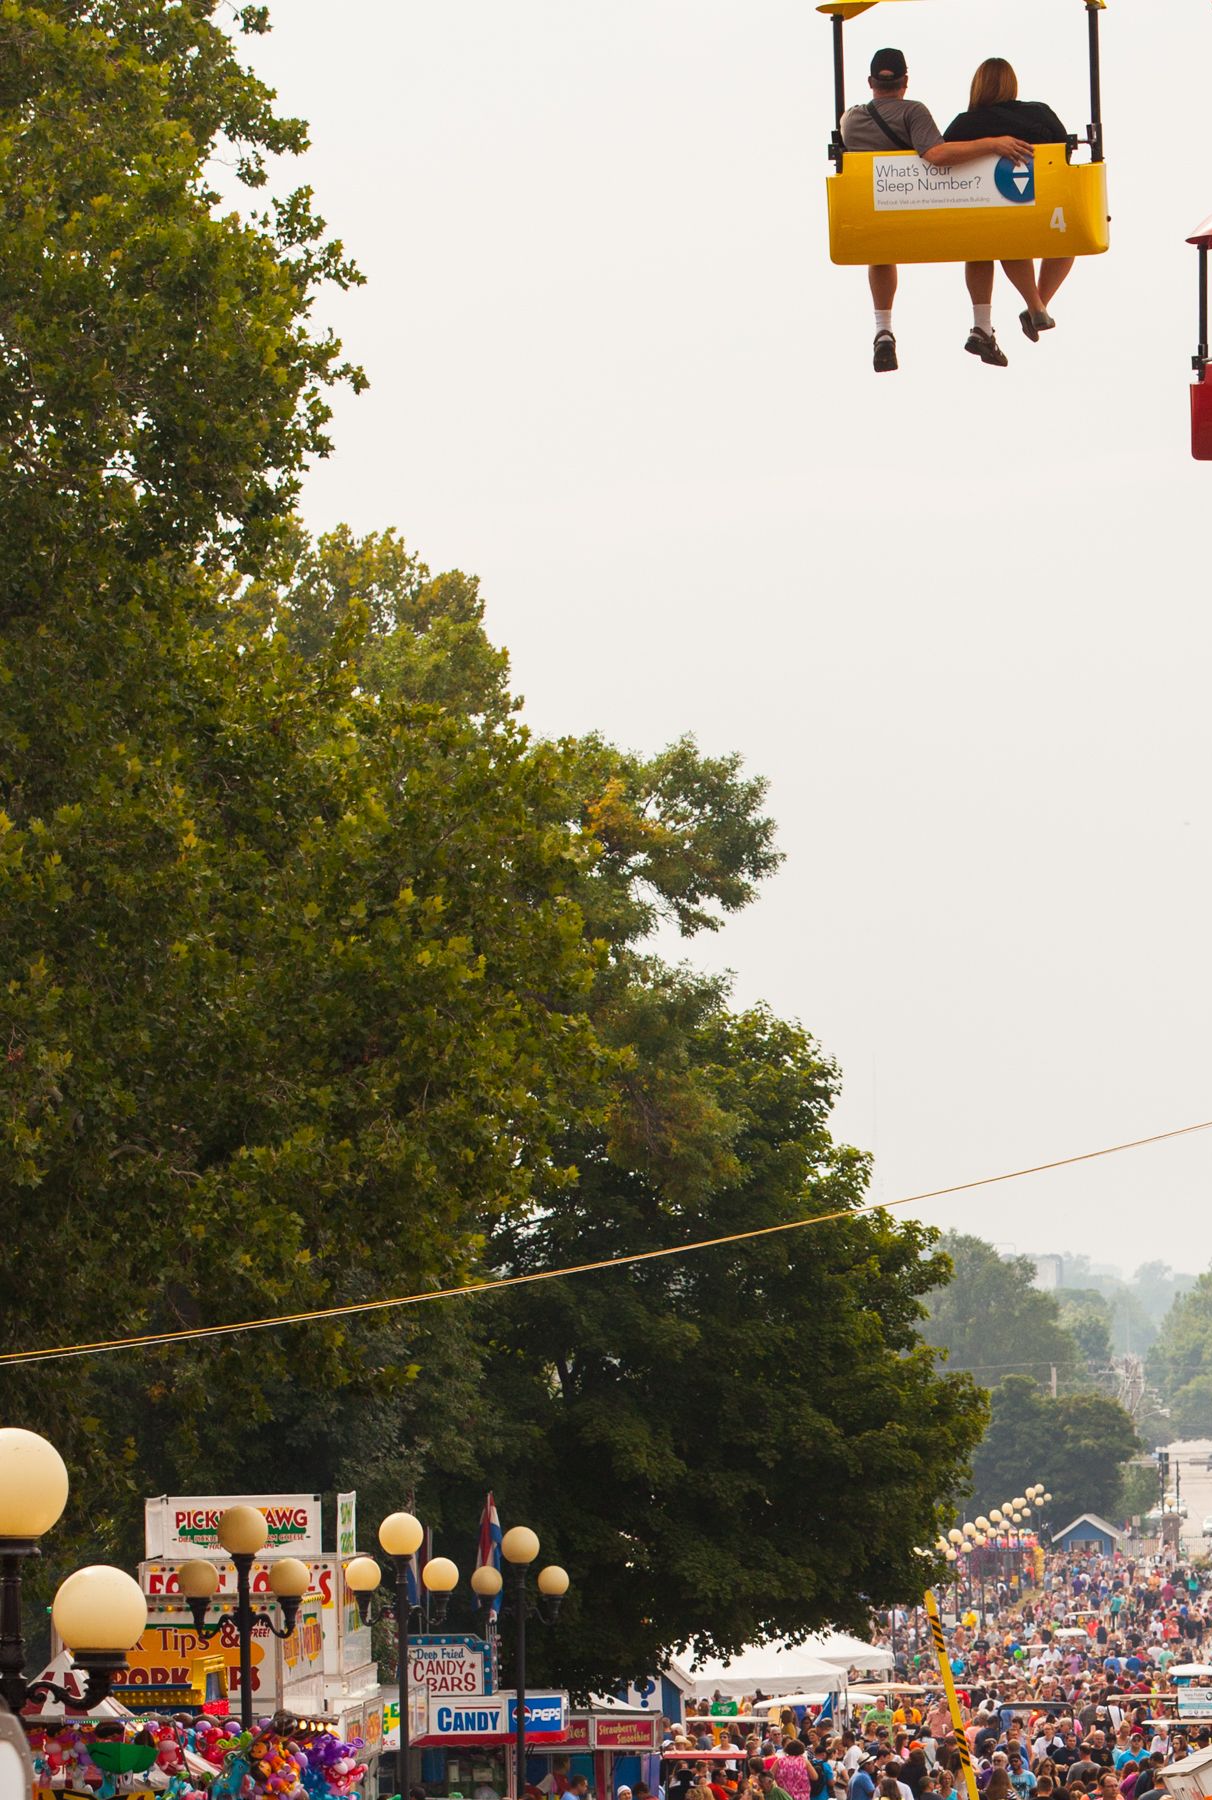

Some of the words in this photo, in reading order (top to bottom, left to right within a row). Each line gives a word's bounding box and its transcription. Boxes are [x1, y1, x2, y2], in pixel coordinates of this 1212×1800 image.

[876, 164, 919, 178] What's
[922, 163, 952, 176] Your
[877, 178, 914, 194] Sleep
[917, 176, 982, 191] Number?
[1050, 207, 1066, 232] 4
[266, 1509, 307, 1529] AWG
[157, 1626, 210, 1658] Tips
[416, 1649, 438, 1661] Deep
[441, 1648, 464, 1659] Fried
[413, 1660, 466, 1682] CANDY
[426, 1672, 476, 1692] BARS
[437, 1707, 499, 1733] CANDY
[599, 1723, 637, 1736] Strawberry
[617, 1732, 650, 1745] Smoothies
